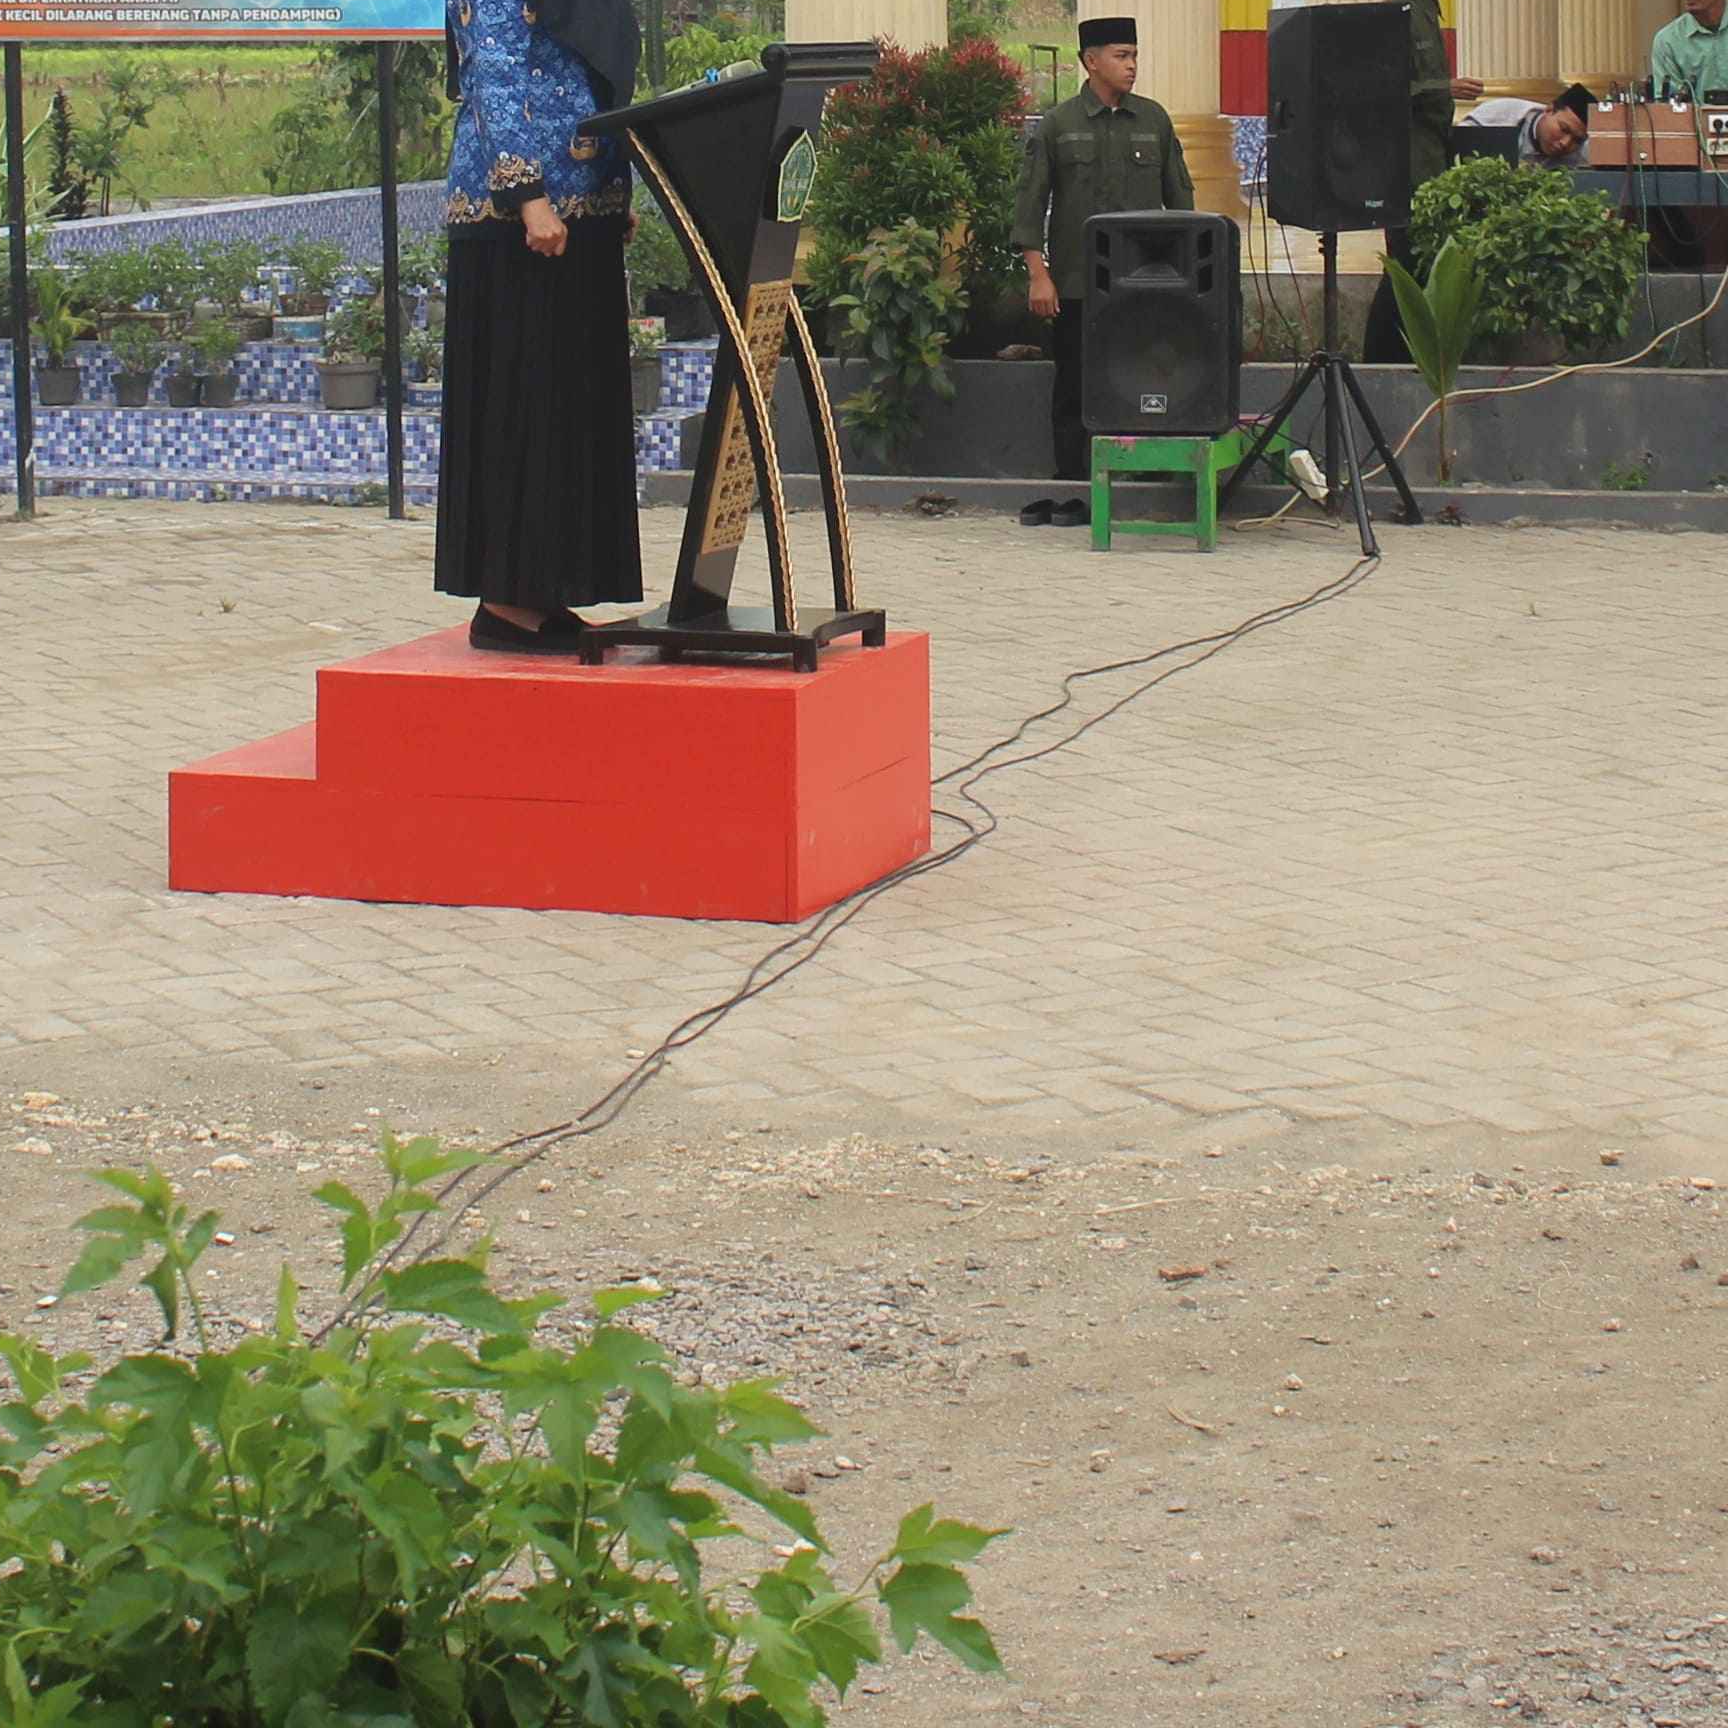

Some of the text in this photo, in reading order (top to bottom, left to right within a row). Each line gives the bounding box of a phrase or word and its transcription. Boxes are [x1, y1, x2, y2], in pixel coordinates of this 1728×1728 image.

[6, 10, 43, 21] KECIL
[45, 10, 113, 21] DILARANG
[116, 9, 191, 21] BERENANG
[192, 9, 241, 21] TANPA
[243, 9, 342, 21] PENDAMPING)
